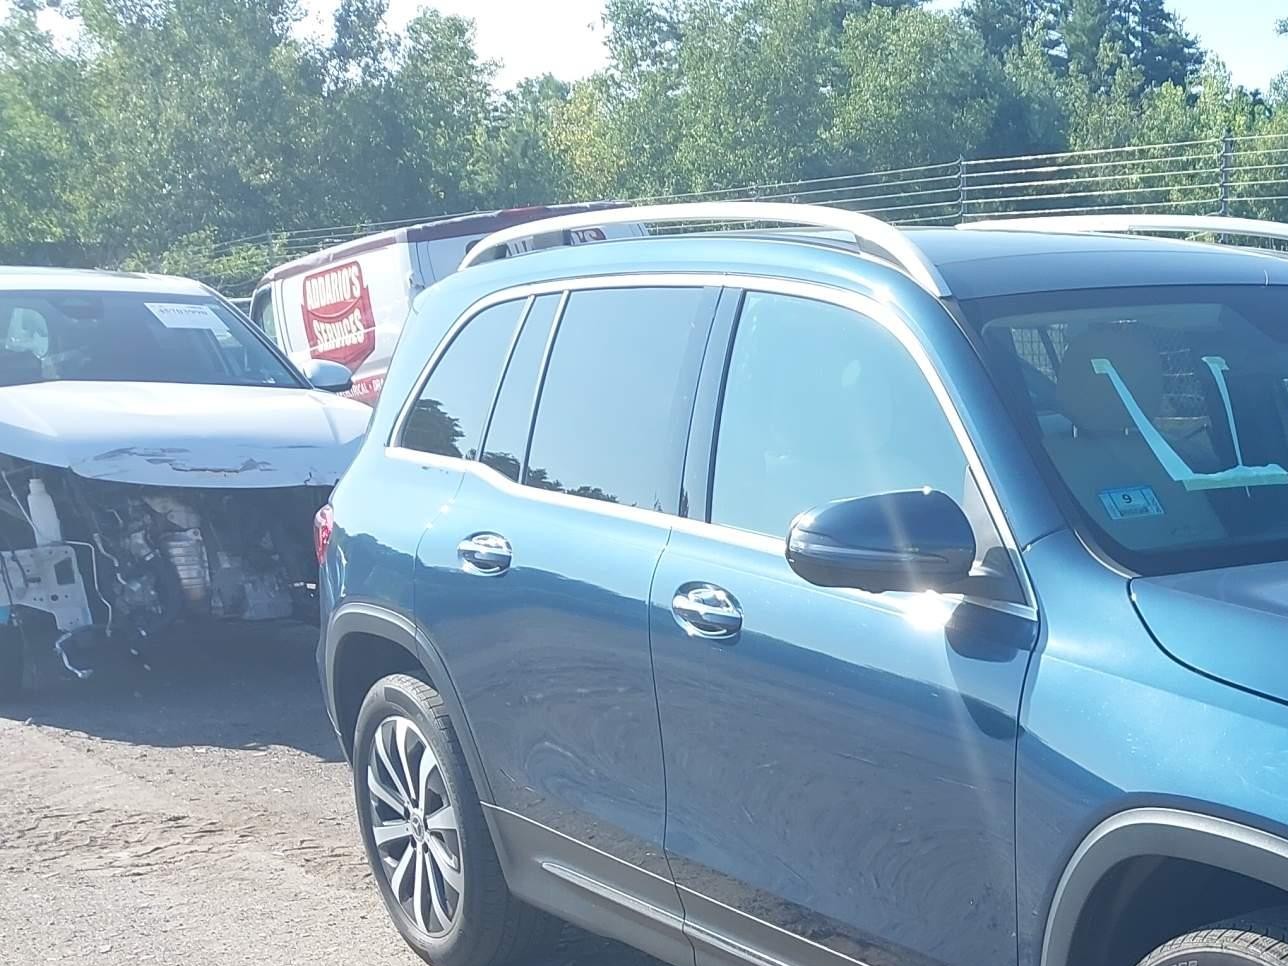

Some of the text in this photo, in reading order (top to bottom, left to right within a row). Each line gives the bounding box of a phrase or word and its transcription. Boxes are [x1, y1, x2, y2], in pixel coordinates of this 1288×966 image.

[306, 265, 360, 310] ADDARIO'S
[314, 309, 365, 352] SERVICES
[1121, 493, 1133, 504] 9
